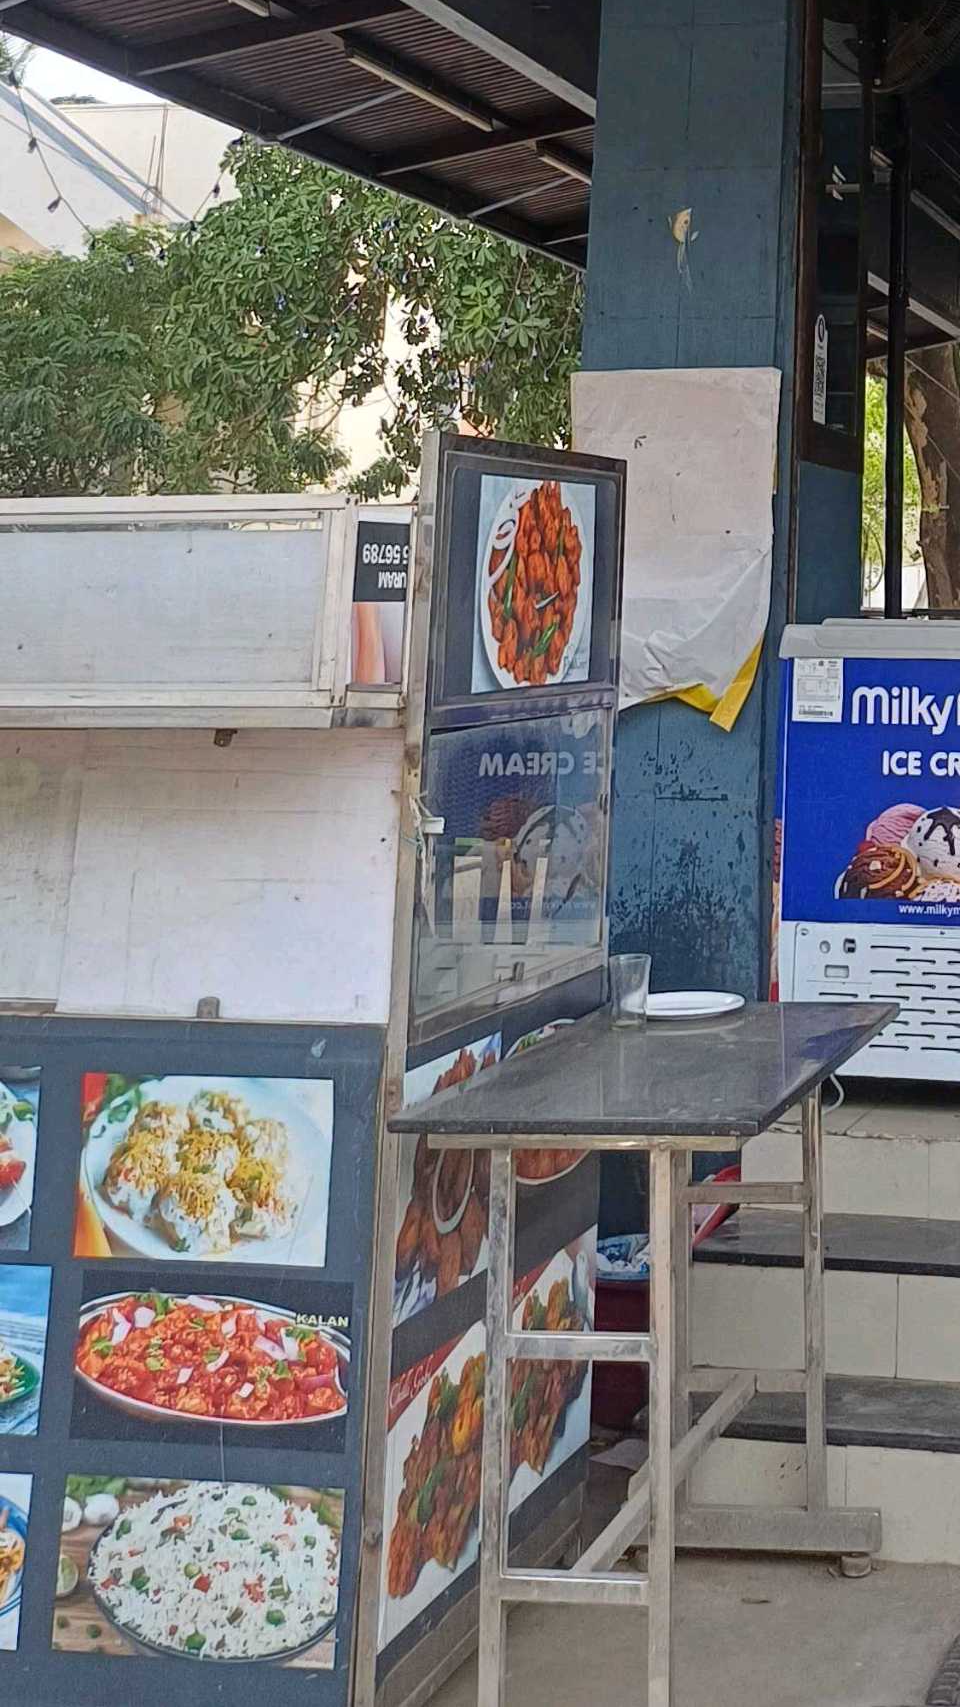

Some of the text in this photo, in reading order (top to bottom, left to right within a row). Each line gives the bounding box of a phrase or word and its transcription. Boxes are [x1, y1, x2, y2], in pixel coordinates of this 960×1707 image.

[362, 543, 401, 565] 56789
[882, 750, 922, 776] ICE
[296, 1313, 349, 1327] KALAN
